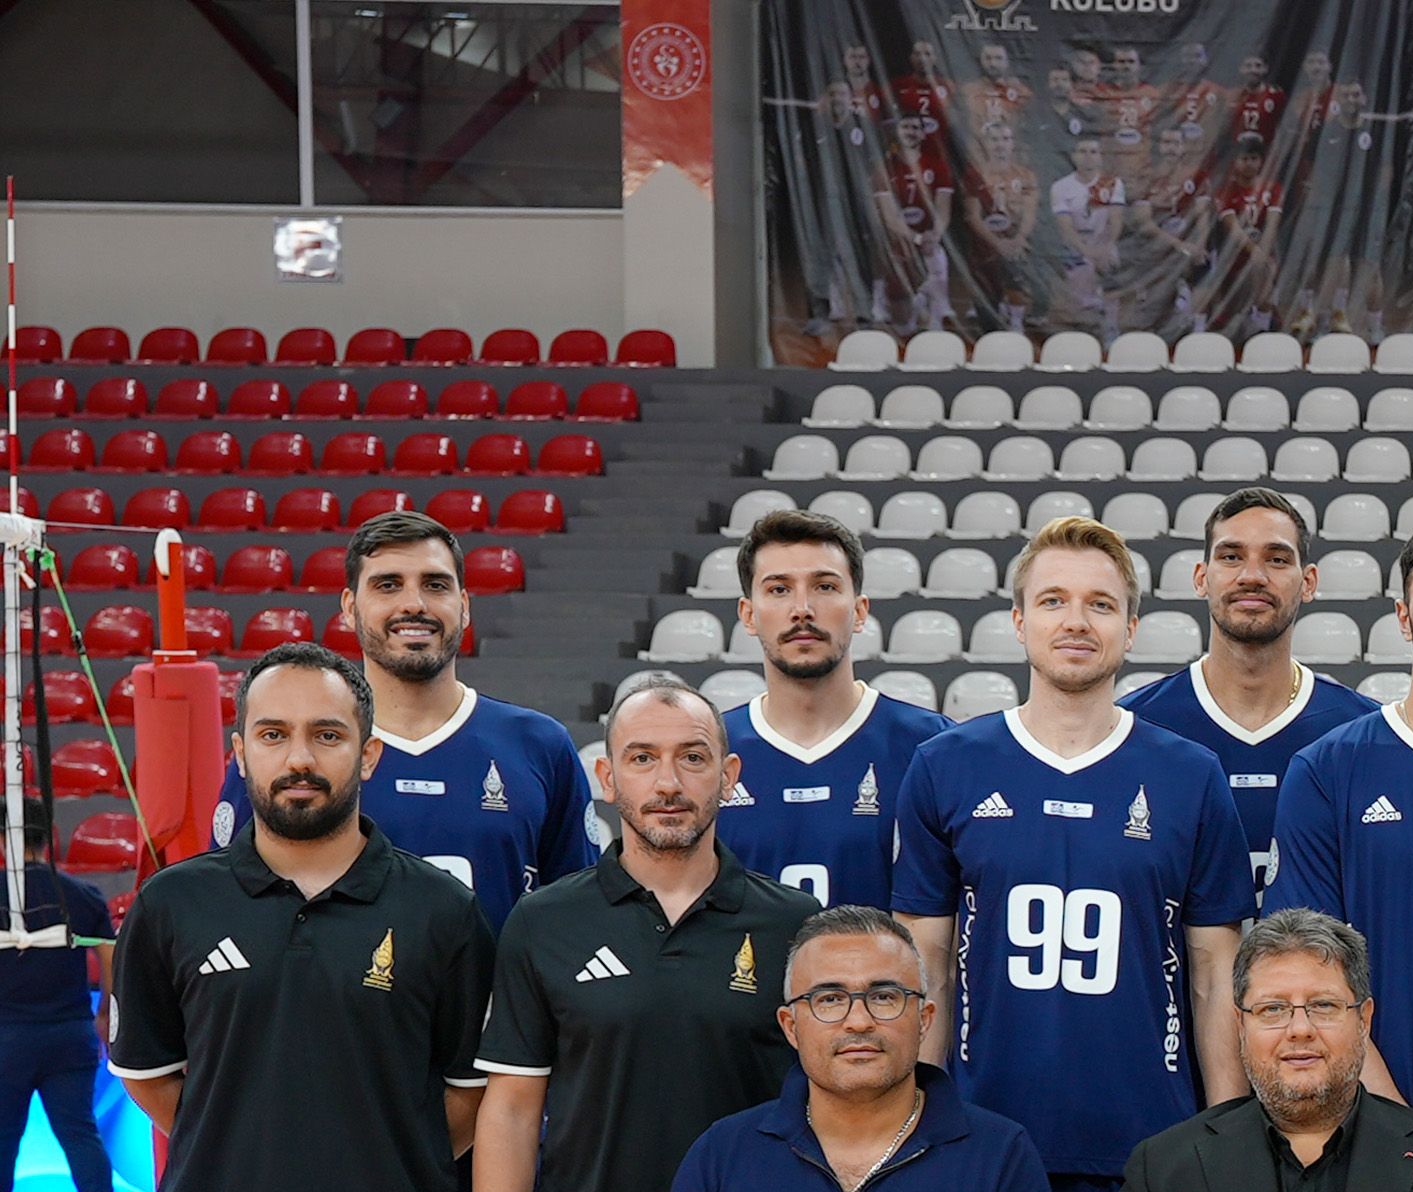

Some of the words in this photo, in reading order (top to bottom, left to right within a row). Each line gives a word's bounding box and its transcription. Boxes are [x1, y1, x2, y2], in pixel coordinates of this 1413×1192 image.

[972, 807, 1013, 818] adidas
[1362, 811, 1402, 823] adidas
[1007, 883, 1122, 995] 99
